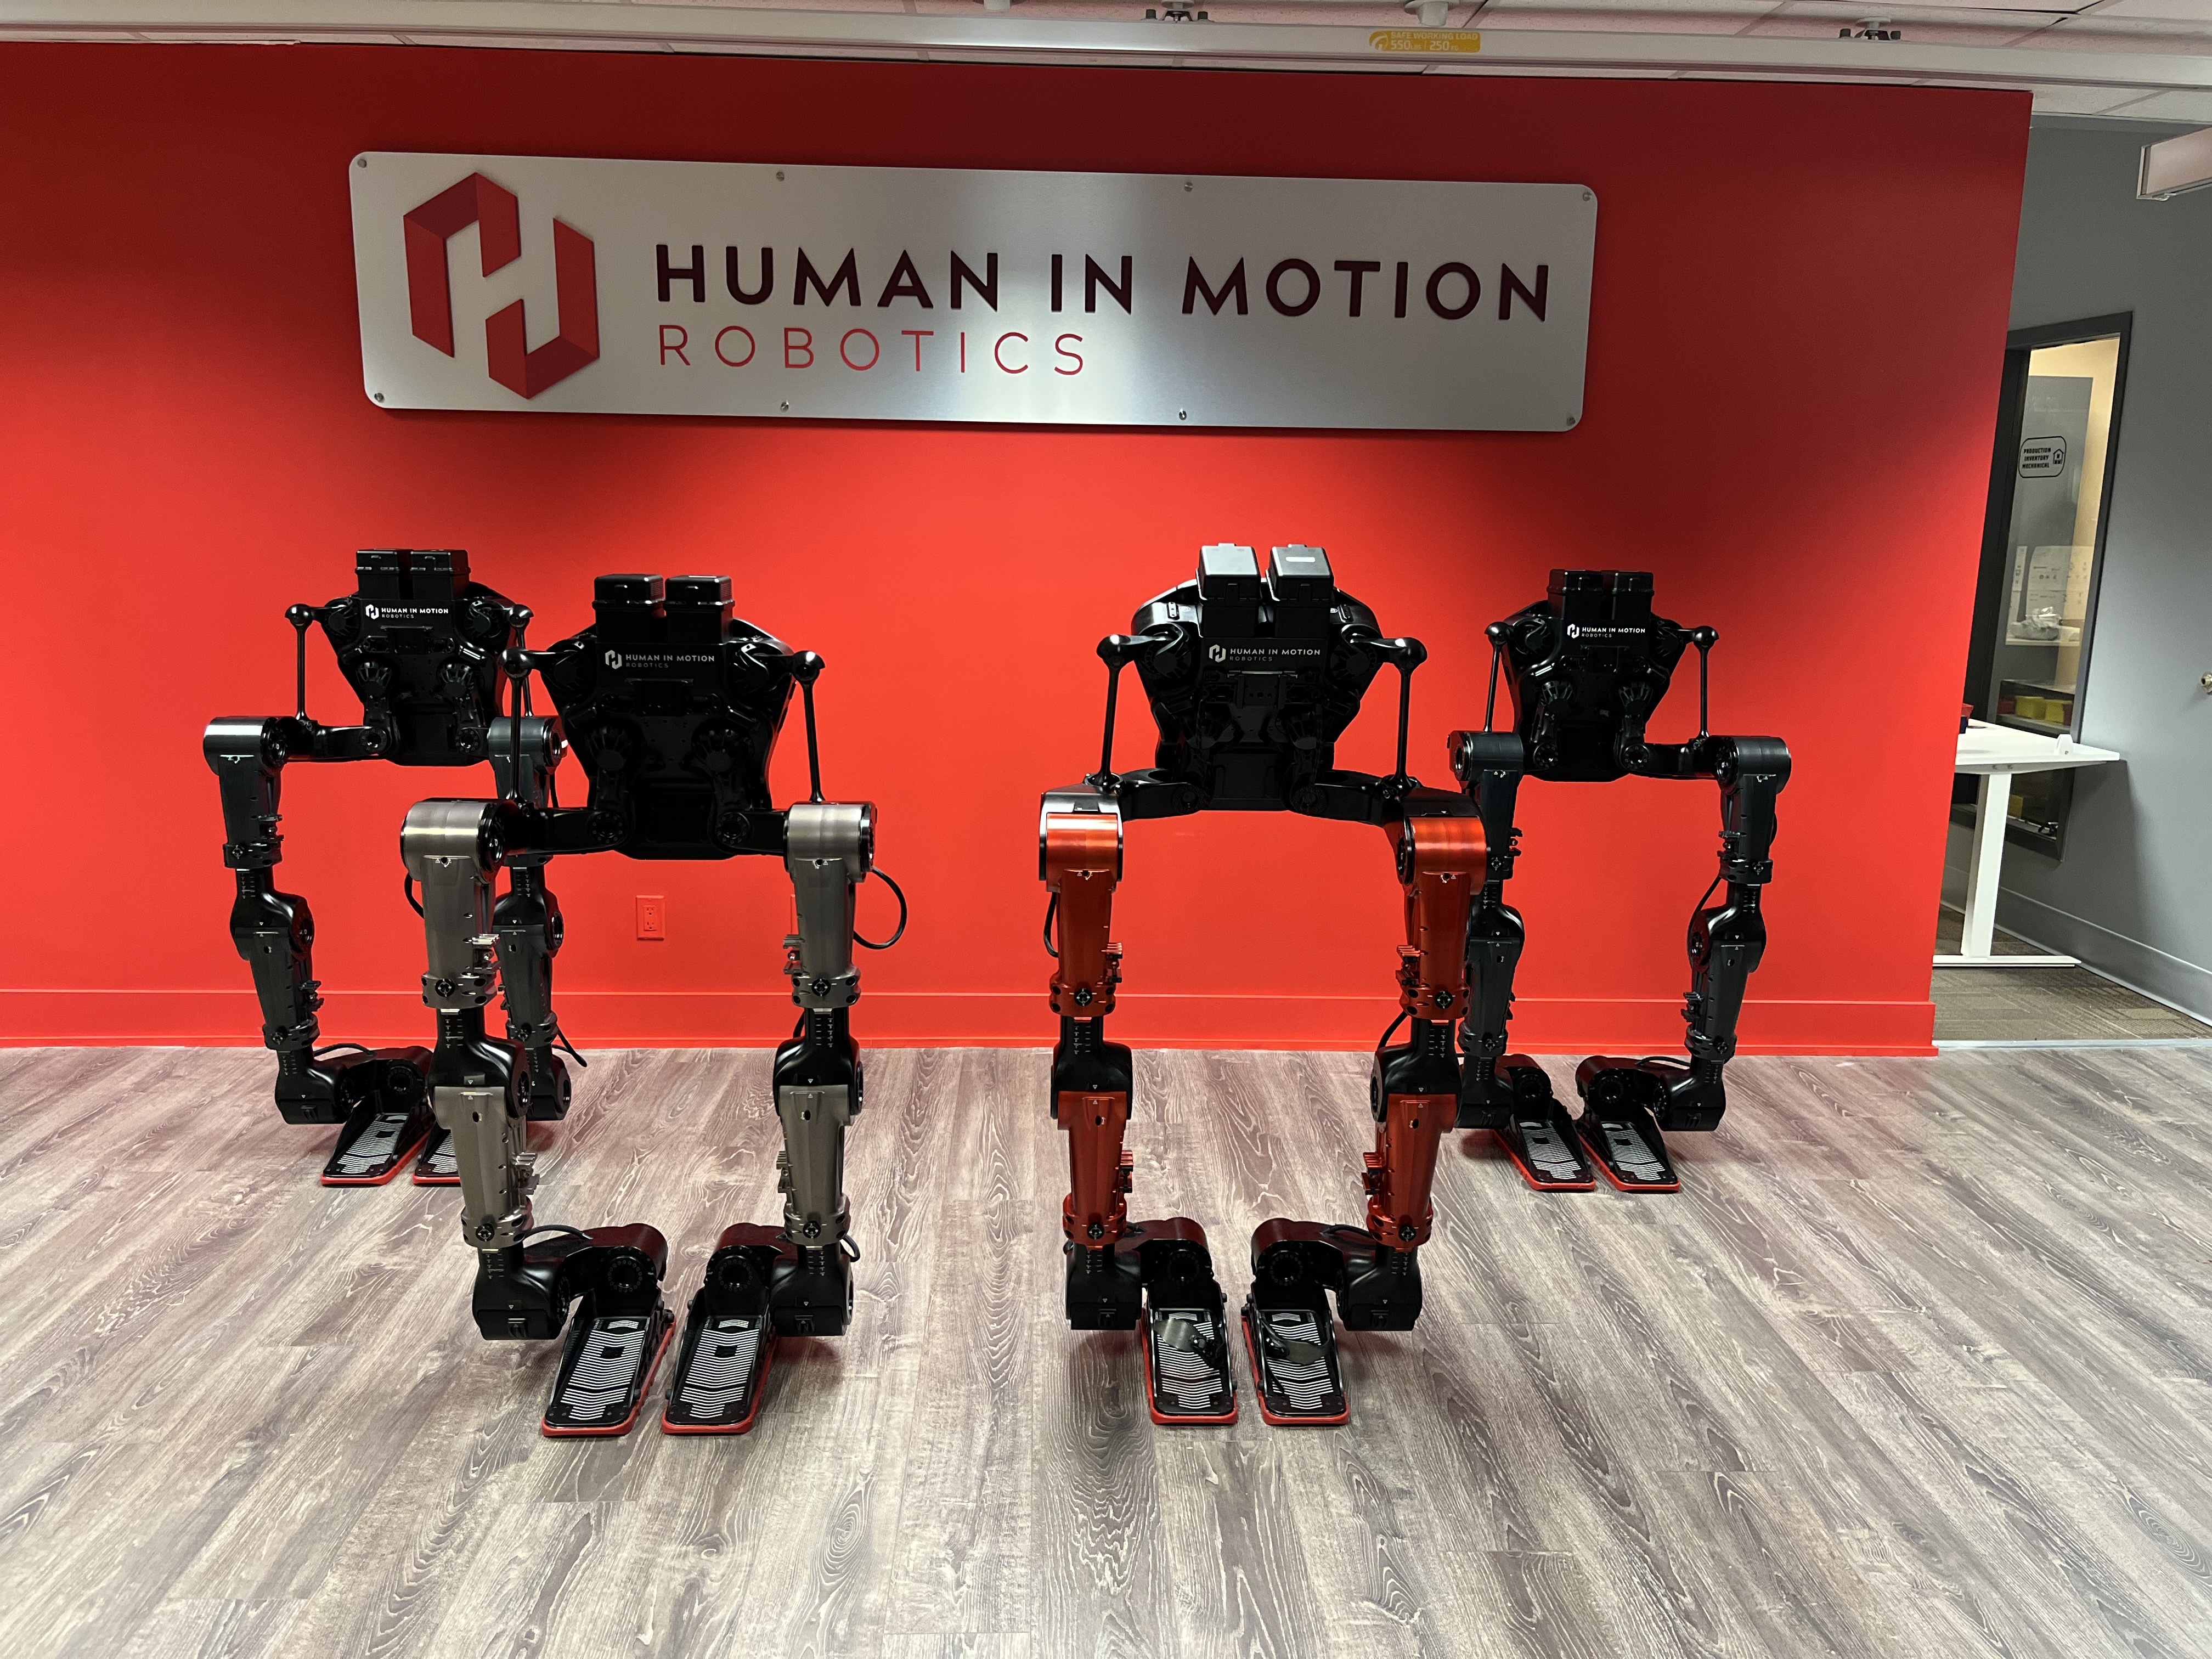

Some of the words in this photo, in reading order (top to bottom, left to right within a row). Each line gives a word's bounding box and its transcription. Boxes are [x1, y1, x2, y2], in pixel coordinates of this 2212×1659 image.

[656, 244, 998, 312] HUMAN
[1051, 253, 1133, 315] IN
[1182, 256, 1549, 322] MOTION
[659, 324, 1083, 375] ROBOTICS
